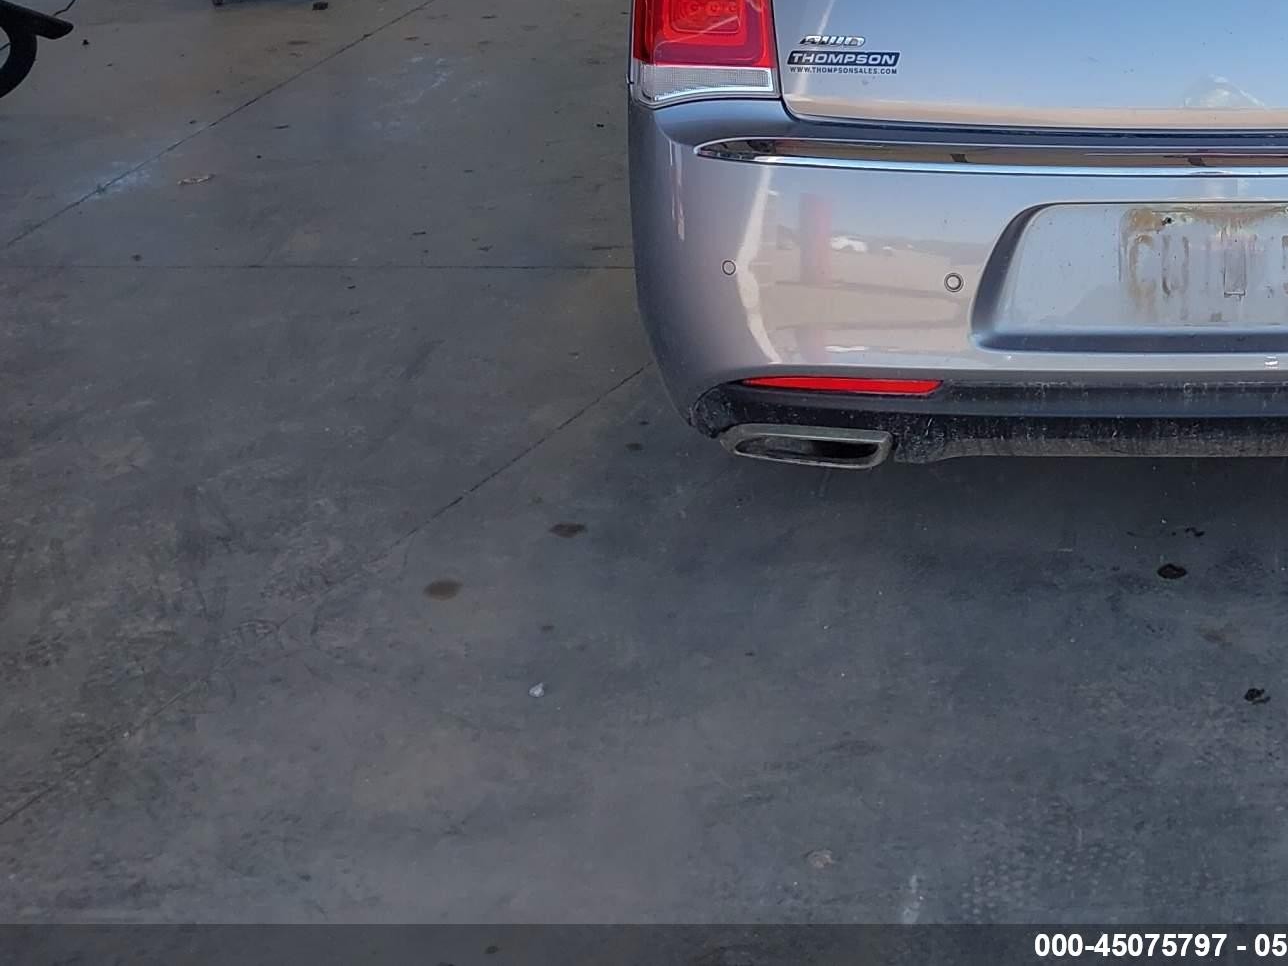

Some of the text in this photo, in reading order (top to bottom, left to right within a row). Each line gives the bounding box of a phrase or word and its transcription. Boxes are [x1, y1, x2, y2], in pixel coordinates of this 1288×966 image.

[800, 35, 865, 47] AWD
[793, 53, 896, 65] THOMPSON
[790, 66, 897, 75] WWW.THOMPSONSALES.COM
